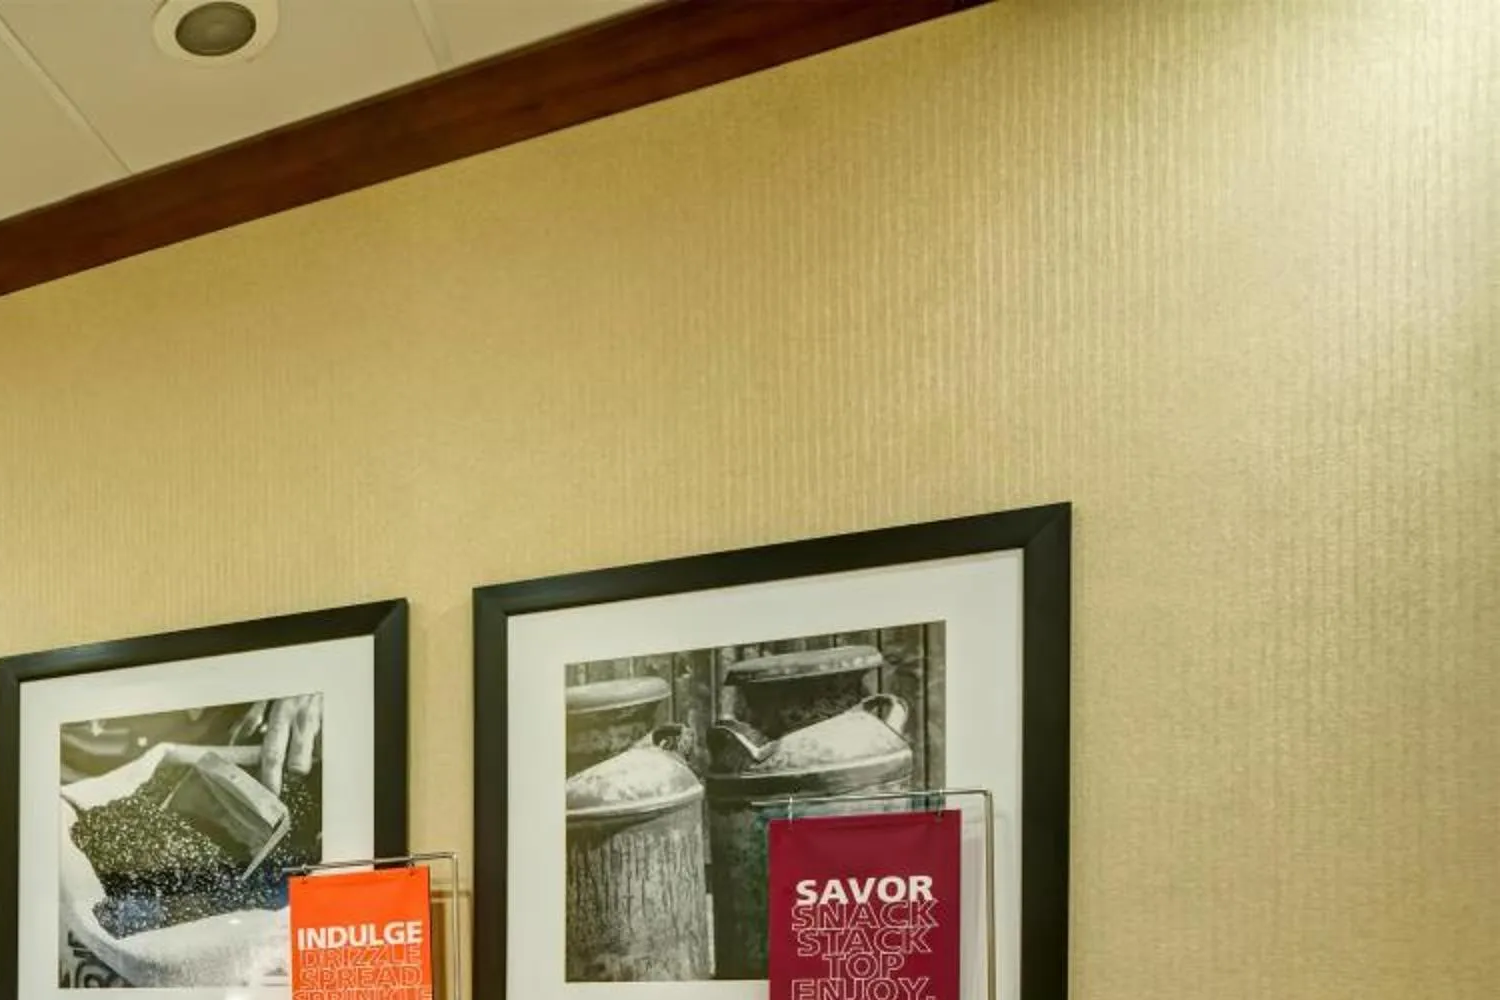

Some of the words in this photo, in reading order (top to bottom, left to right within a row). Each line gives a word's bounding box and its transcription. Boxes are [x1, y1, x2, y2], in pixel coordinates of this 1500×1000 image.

[796, 875, 934, 905] SAVOR
[792, 900, 939, 931] SNACK
[297, 920, 424, 950] INDULGE
[797, 926, 932, 957] STACK
[302, 944, 422, 970] DRIZZLE
[822, 950, 905, 981] TOP
[300, 963, 423, 990] SPREAD
